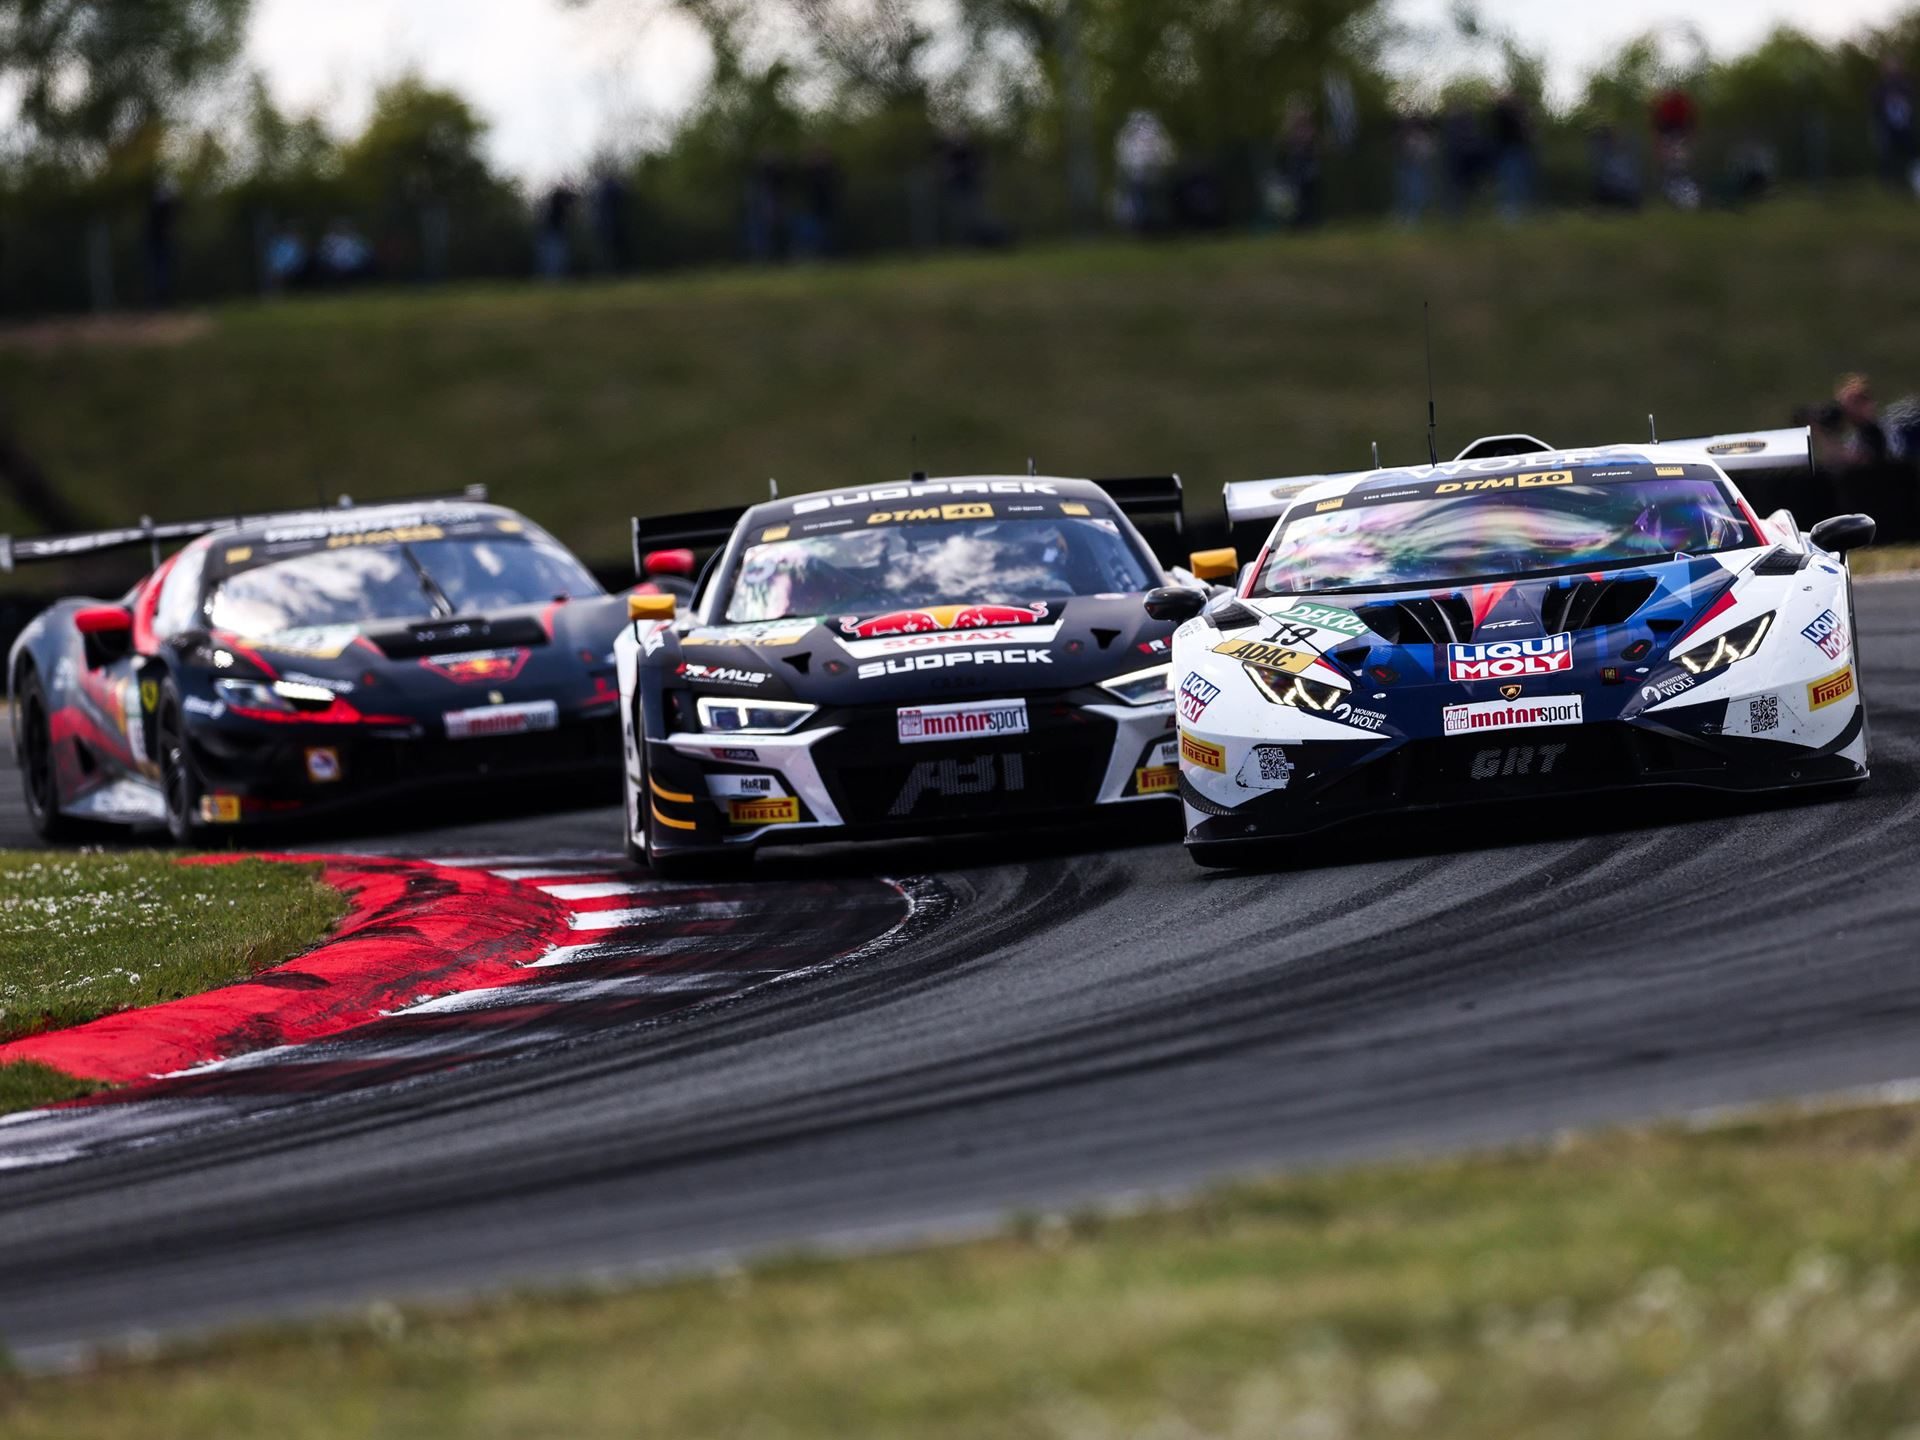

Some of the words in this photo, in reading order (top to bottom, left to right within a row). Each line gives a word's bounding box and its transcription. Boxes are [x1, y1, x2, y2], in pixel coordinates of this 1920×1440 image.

[1435, 477, 1515, 494] DTM
[1525, 473, 1566, 484] 40
[866, 507, 941, 524] DTM
[950, 505, 984, 515] 40
[1287, 605, 1369, 635] DEKRA
[1803, 610, 1840, 643] LIQUI
[883, 630, 1017, 649] SONAX
[1262, 622, 1318, 646] 19
[1229, 642, 1297, 667] ADAC
[1455, 636, 1564, 661] LIQUI
[1456, 651, 1569, 679] MOLY
[1182, 673, 1220, 704] LIQUI
[1656, 672, 1689, 690] MOUNTAIN
[1660, 676, 1696, 696] WOLF
[924, 706, 1027, 735] motorsport
[1349, 713, 1383, 730] WOLF
[1354, 707, 1387, 720] MOUNTAIN
[1471, 702, 1581, 728] motorsport
[1182, 736, 1220, 767] PIRELLI
[1471, 743, 1568, 780] GRT
[732, 801, 793, 820] PIRELLI
